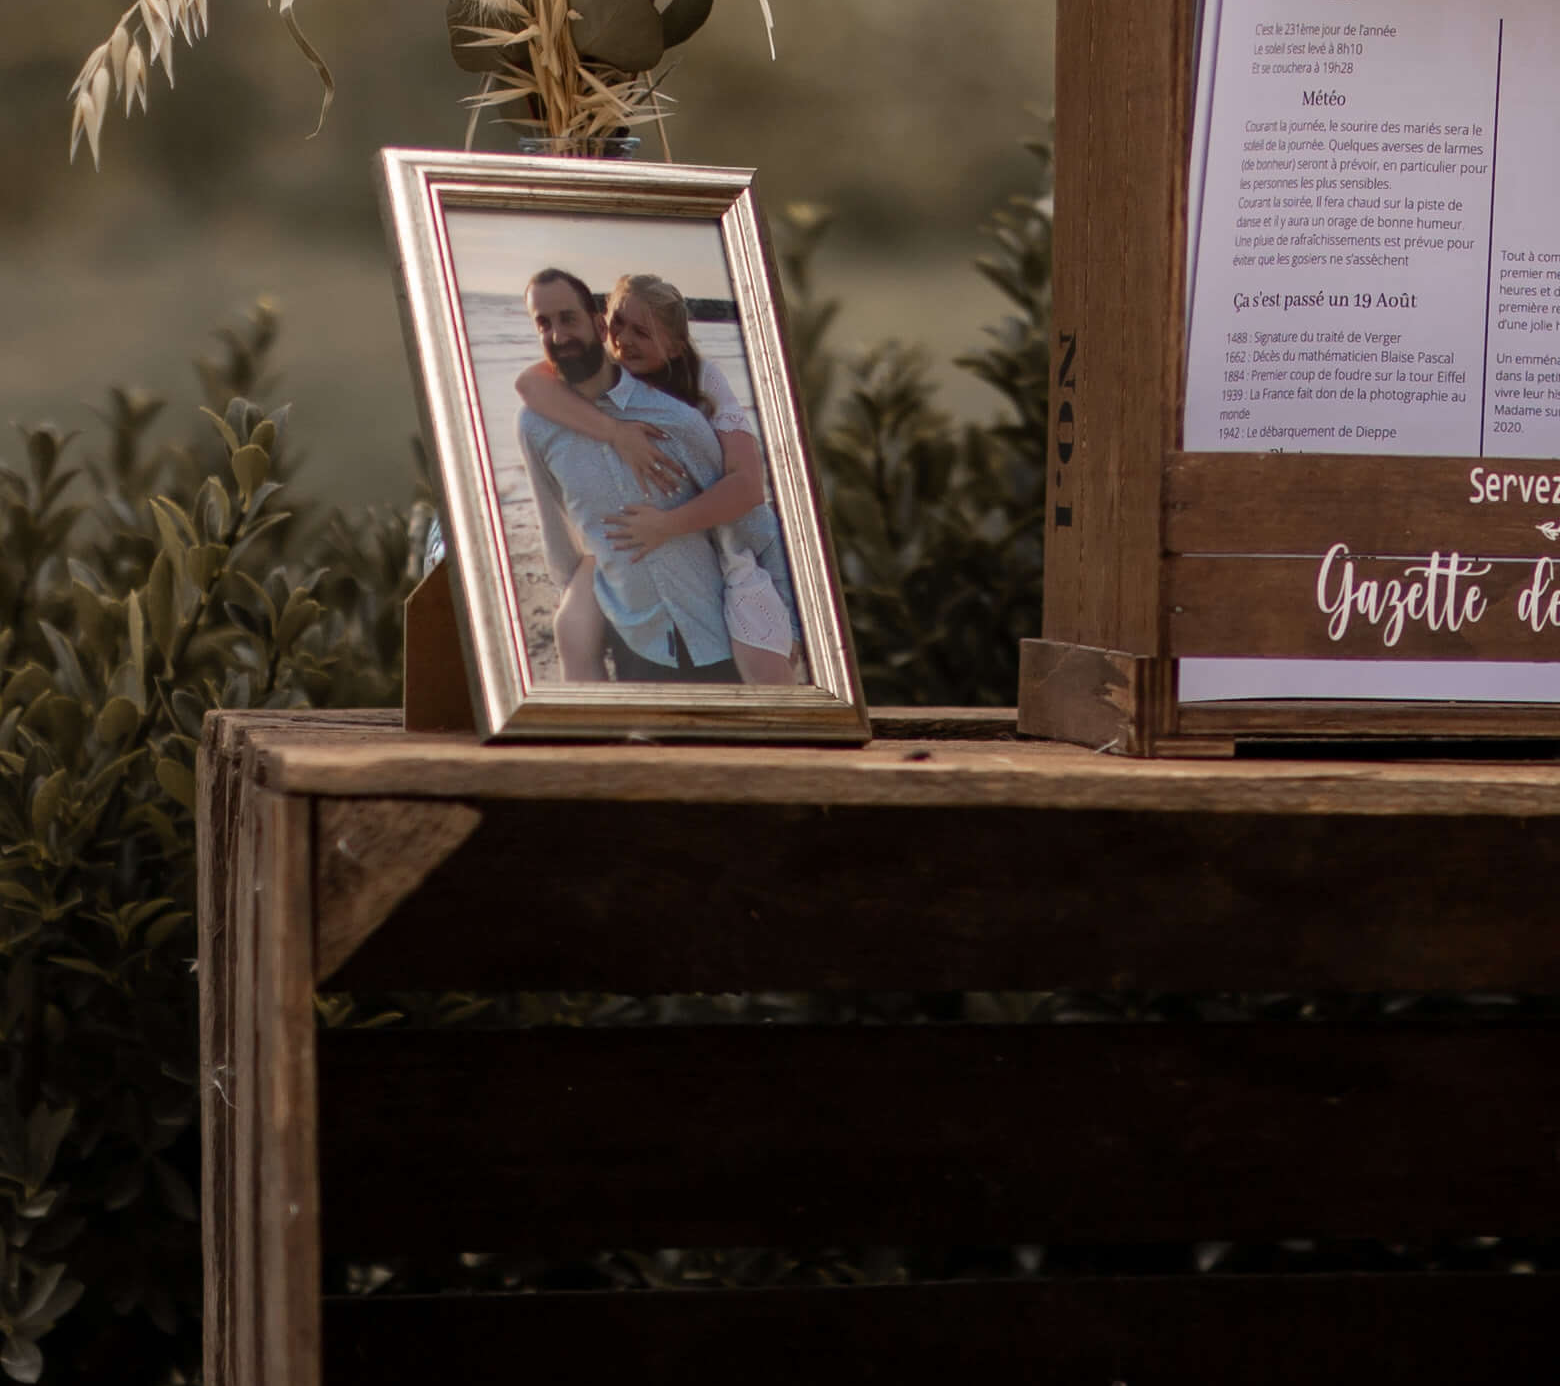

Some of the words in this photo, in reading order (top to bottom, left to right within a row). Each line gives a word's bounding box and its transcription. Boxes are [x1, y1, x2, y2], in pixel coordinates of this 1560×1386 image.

[1302, 89, 1346, 106] Météo
[1501, 249, 1525, 262] Tout
[1527, 250, 1535, 262] à
[1499, 268, 1544, 281] premier
[1499, 283, 1537, 297] heures
[1539, 286, 1551, 297] et
[1233, 292, 1250, 313] Ça
[1252, 291, 1280, 307] s'est
[1283, 290, 1325, 311] passé
[1329, 294, 1349, 308] un
[1353, 293, 1372, 309] 19
[1375, 292, 1416, 308] Août
[1498, 301, 1549, 315] première
[1497, 318, 1528, 330] d'une
[1529, 319, 1553, 333] jolie
[1297, 348, 1378, 362] mathématicien
[1380, 350, 1415, 363] Blaise
[1417, 351, 1454, 364] Pascal
[1496, 352, 1512, 364] Un
[1334, 367, 1372, 381] foudre
[1374, 371, 1393, 382] sur
[1395, 369, 1406, 382] la
[1406, 372, 1434, 382] tour
[1436, 370, 1466, 384] Eiffel
[1495, 369, 1522, 382] dans
[1524, 370, 1535, 382] la
[1315, 387, 1337, 399] don
[1339, 386, 1356, 400] de
[1356, 387, 1367, 400] la
[1369, 388, 1449, 404] photographie
[1450, 392, 1466, 402] au
[1494, 387, 1521, 399] vivre
[1522, 387, 1545, 399] leur
[1494, 404, 1543, 417] Madame
[1259, 425, 1335, 439] débarquement
[1337, 424, 1353, 437] de
[1355, 425, 1397, 441] Dieppe
[1492, 420, 1524, 433] 2020.
[1316, 543, 1491, 647] Gazette
